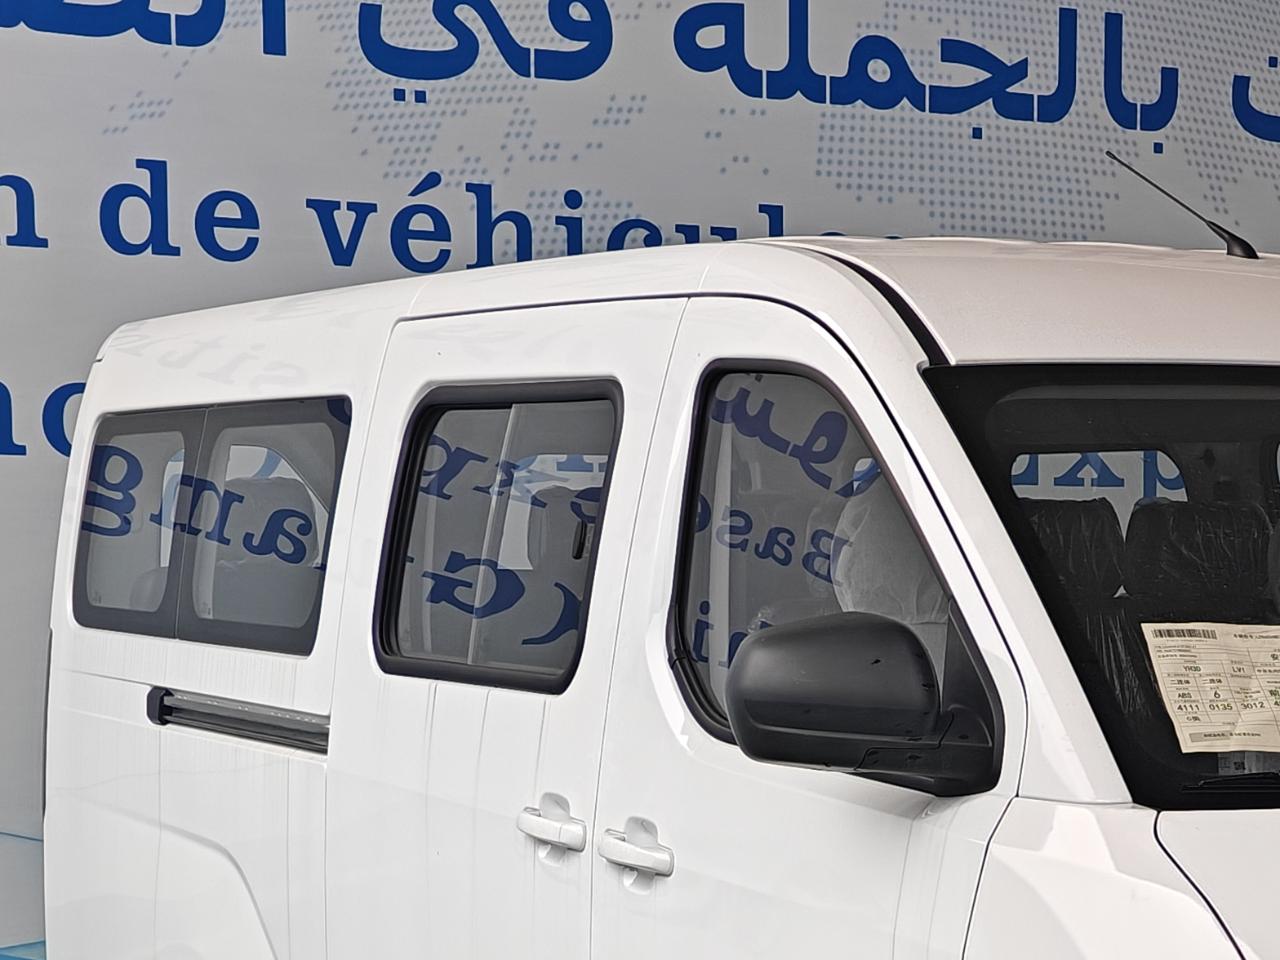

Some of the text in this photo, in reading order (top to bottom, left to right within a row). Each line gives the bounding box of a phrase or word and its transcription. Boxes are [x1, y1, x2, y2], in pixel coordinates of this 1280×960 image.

[99, 157, 261, 263] de
[1213, 690, 1221, 699] 6
[1208, 703, 1233, 711] 0135
[1241, 702, 1266, 710] 3012
